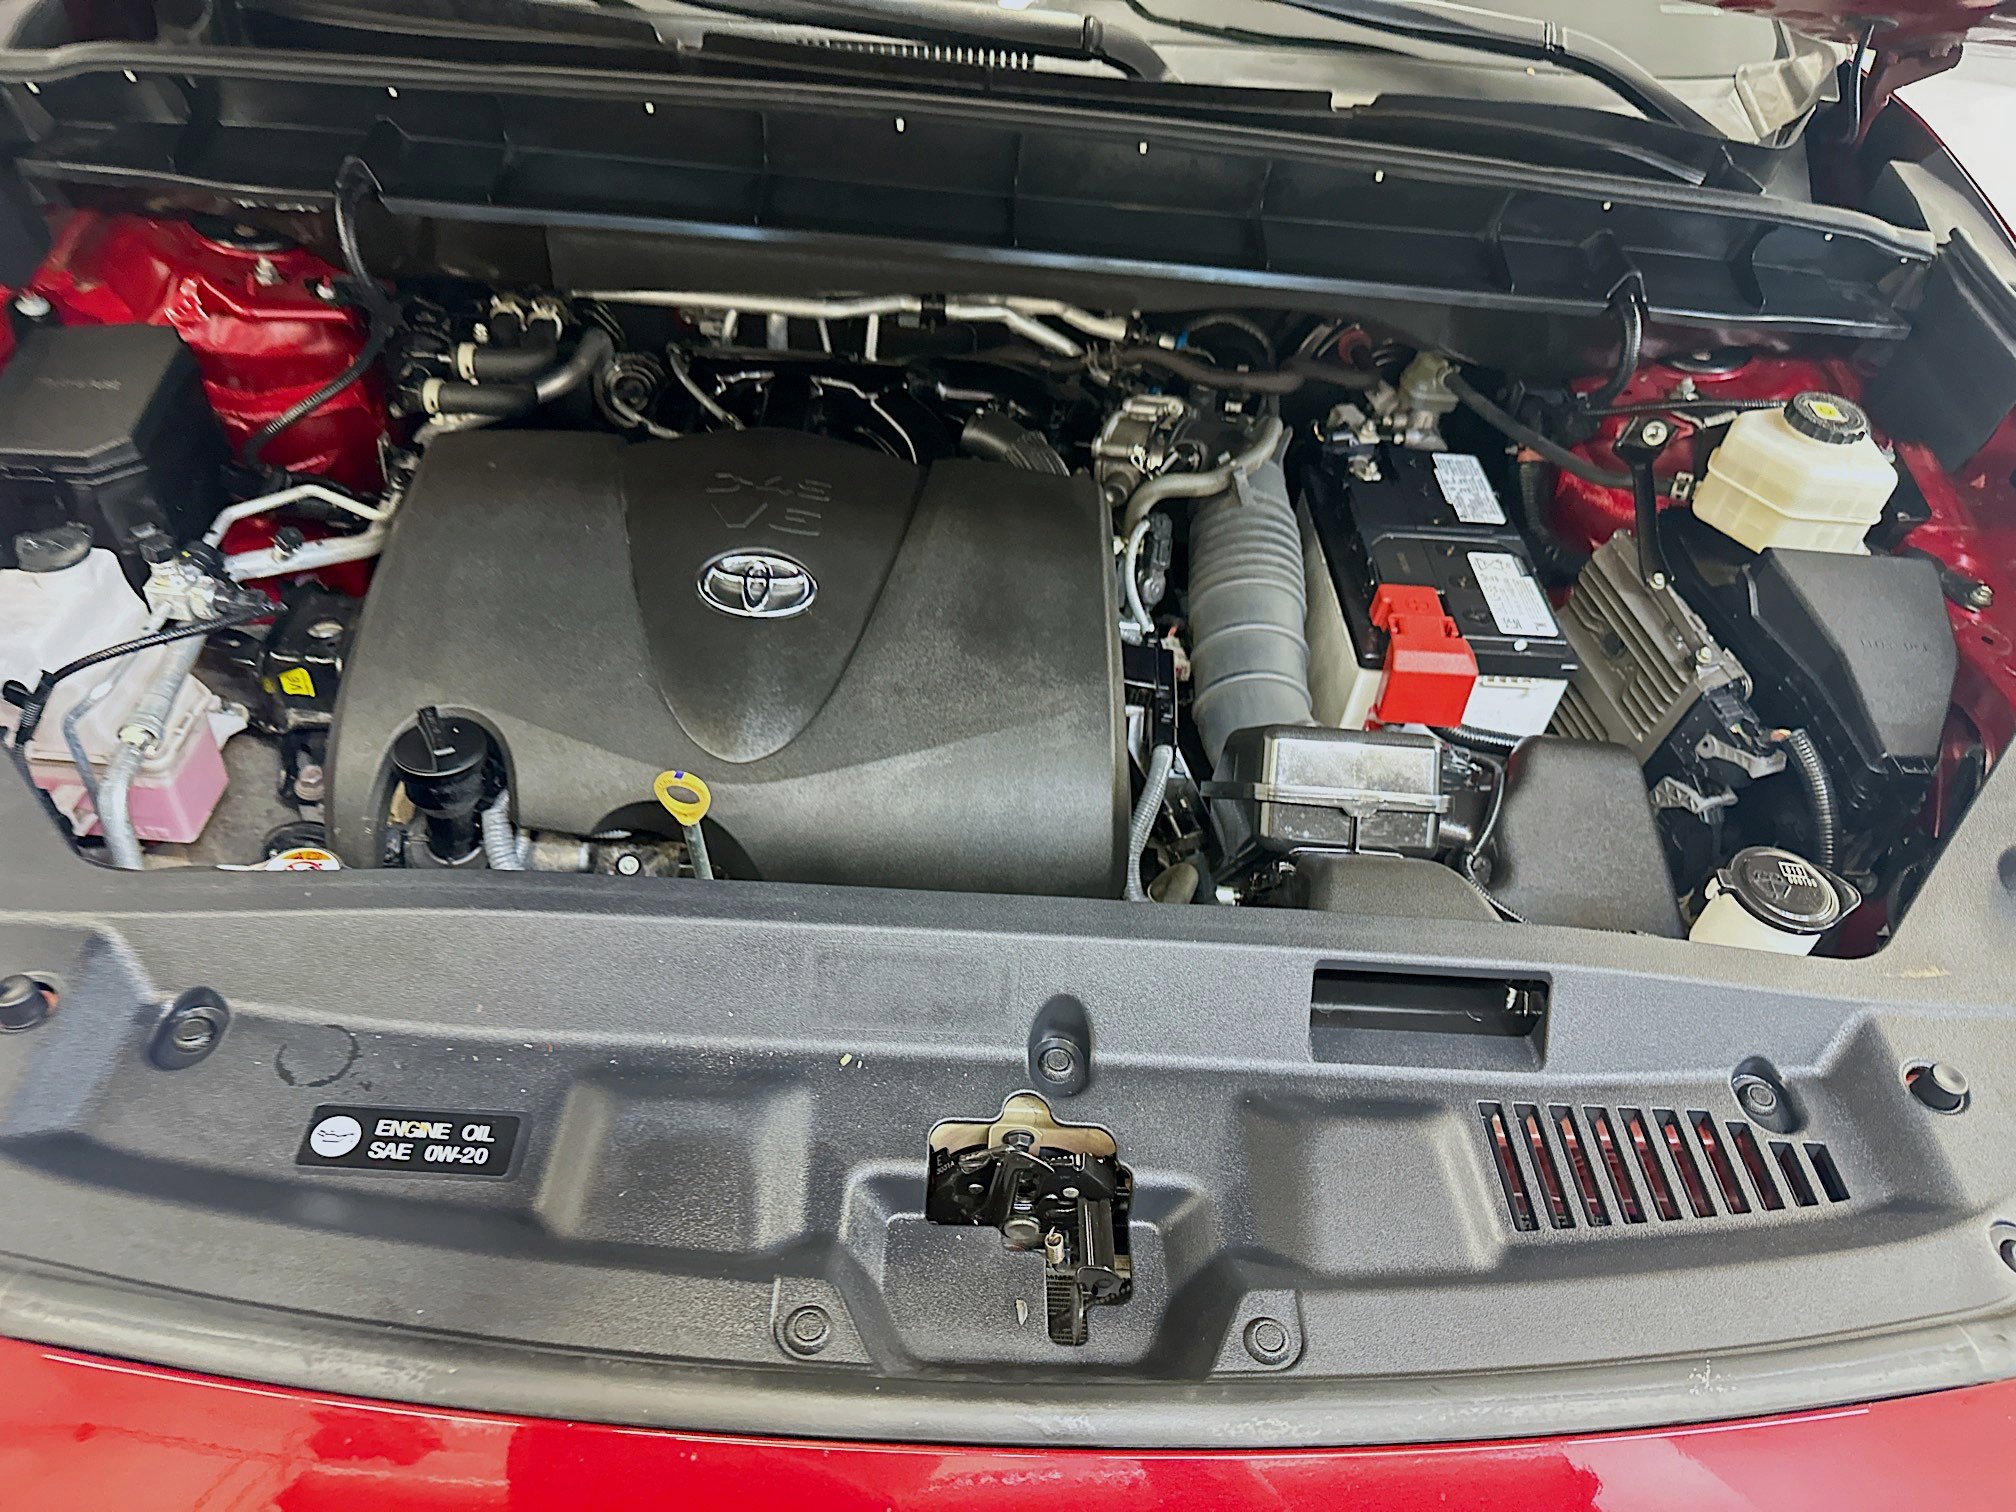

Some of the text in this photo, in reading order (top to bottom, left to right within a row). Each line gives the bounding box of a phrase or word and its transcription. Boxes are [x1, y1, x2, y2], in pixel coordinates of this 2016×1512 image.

[374, 1119, 496, 1143] ENGINE OIL
[367, 1141, 489, 1165] SAE 0W-20
